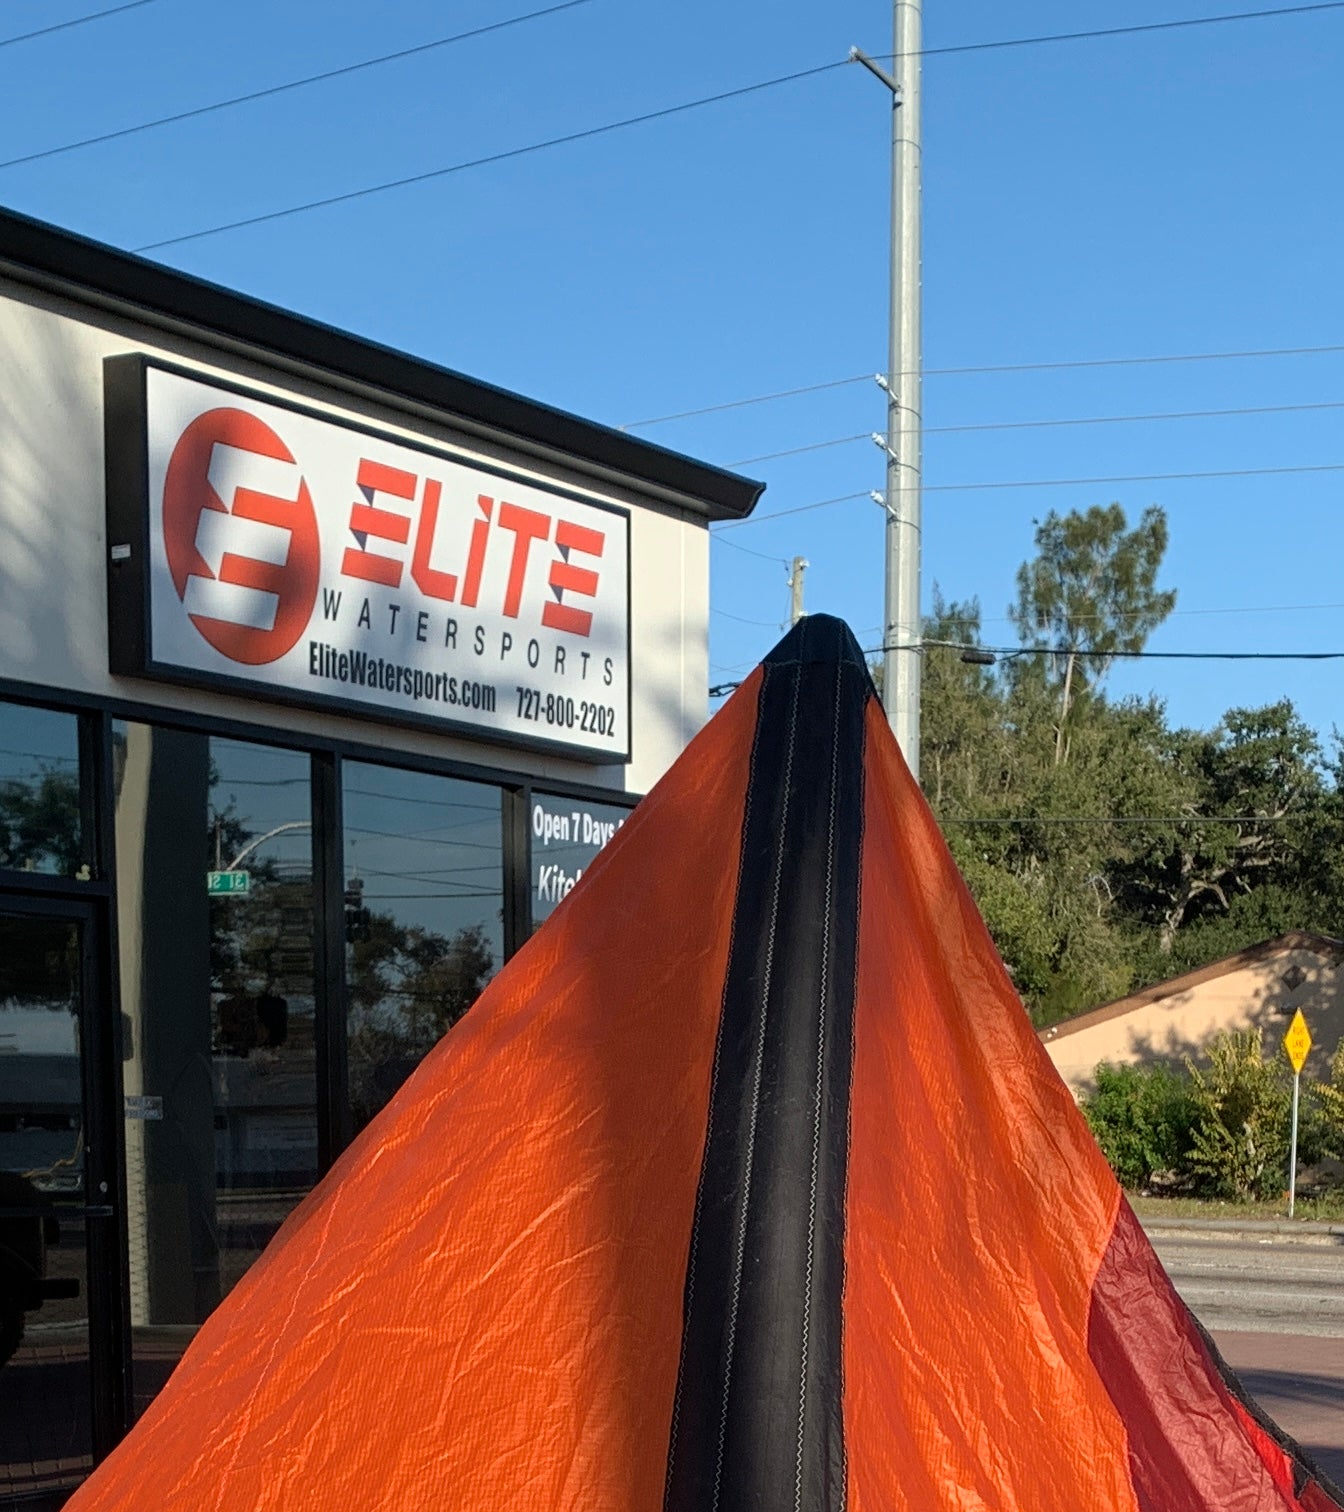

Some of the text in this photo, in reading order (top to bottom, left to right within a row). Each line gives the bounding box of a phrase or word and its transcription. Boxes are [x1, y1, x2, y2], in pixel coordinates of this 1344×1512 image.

[323, 588, 614, 686] WATERSPORTS
[309, 641, 615, 737] EliteWatersports.com 727-800-2202
[533, 804, 615, 850] Open 7 Days
[538, 865, 582, 904] Kite
